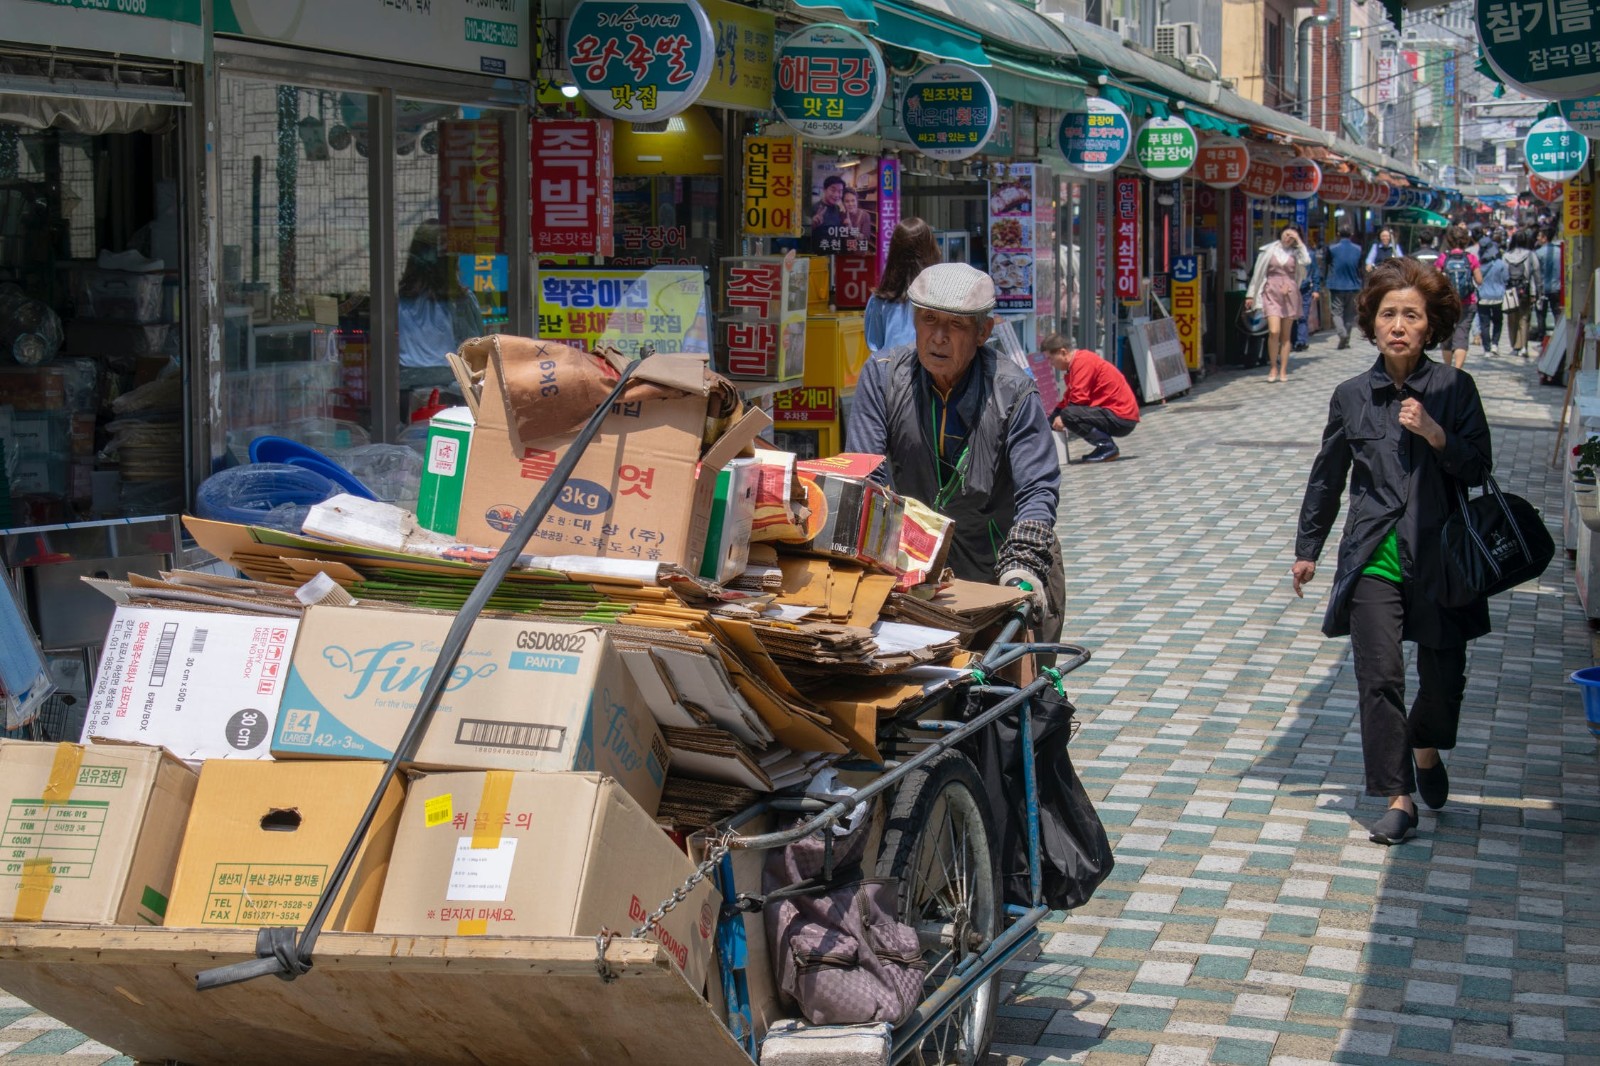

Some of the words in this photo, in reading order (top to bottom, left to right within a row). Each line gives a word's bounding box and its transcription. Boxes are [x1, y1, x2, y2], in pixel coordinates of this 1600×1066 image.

[570, 34, 695, 84] 왕족발
[778, 55, 875, 96] 해금강
[611, 84, 657, 110] 맛집
[922, 87, 973, 101] 원조맛집
[803, 98, 844, 118] 맛집
[1148, 132, 1184, 145] 푸짐한
[1138, 146, 1193, 162] 산곰장어
[539, 129, 596, 228] 족발
[747, 142, 769, 229] 연탄구이
[771, 143, 794, 229] 곰장어
[883, 169, 894, 192] 회
[1119, 183, 1136, 219] 연탄
[538, 231, 593, 246] 원조맛집
[623, 225, 687, 250] 곰장어
[819, 240, 842, 252] 추천
[1118, 222, 1136, 295] 석쇠구이
[1173, 258, 1196, 279] 산
[543, 277, 648, 308] 확장이전
[567, 311, 646, 334] 냉채족발
[650, 314, 682, 334] 맛집
[726, 267, 773, 376] 족발
[784, 411, 808, 421] 주차장
[561, 485, 600, 510] 3kg
[831, 542, 849, 554] 10kg
[123, 619, 136, 640] 경기도
[252, 627, 262, 643] USE
[260, 627, 270, 650] KEEP
[516, 630, 586, 654] GSD08022
[524, 655, 566, 670] PANTY
[240, 711, 258, 727] 30
[297, 712, 312, 732] 4
[235, 727, 251, 747] cm
[283, 732, 311, 745] LARGE
[79, 768, 122, 785] 섬유잡화
[12, 836, 32, 845] COLOR
[12, 850, 26, 858] SIZE
[58, 866, 71, 874] SET
[218, 873, 243, 885] 생산지
[249, 873, 265, 886] 부산
[268, 874, 291, 887] 강서구
[294, 874, 320, 887] 명지동
[214, 898, 232, 908] TEL
[210, 910, 230, 920] FAX
[440, 908, 475, 922] 던지지
